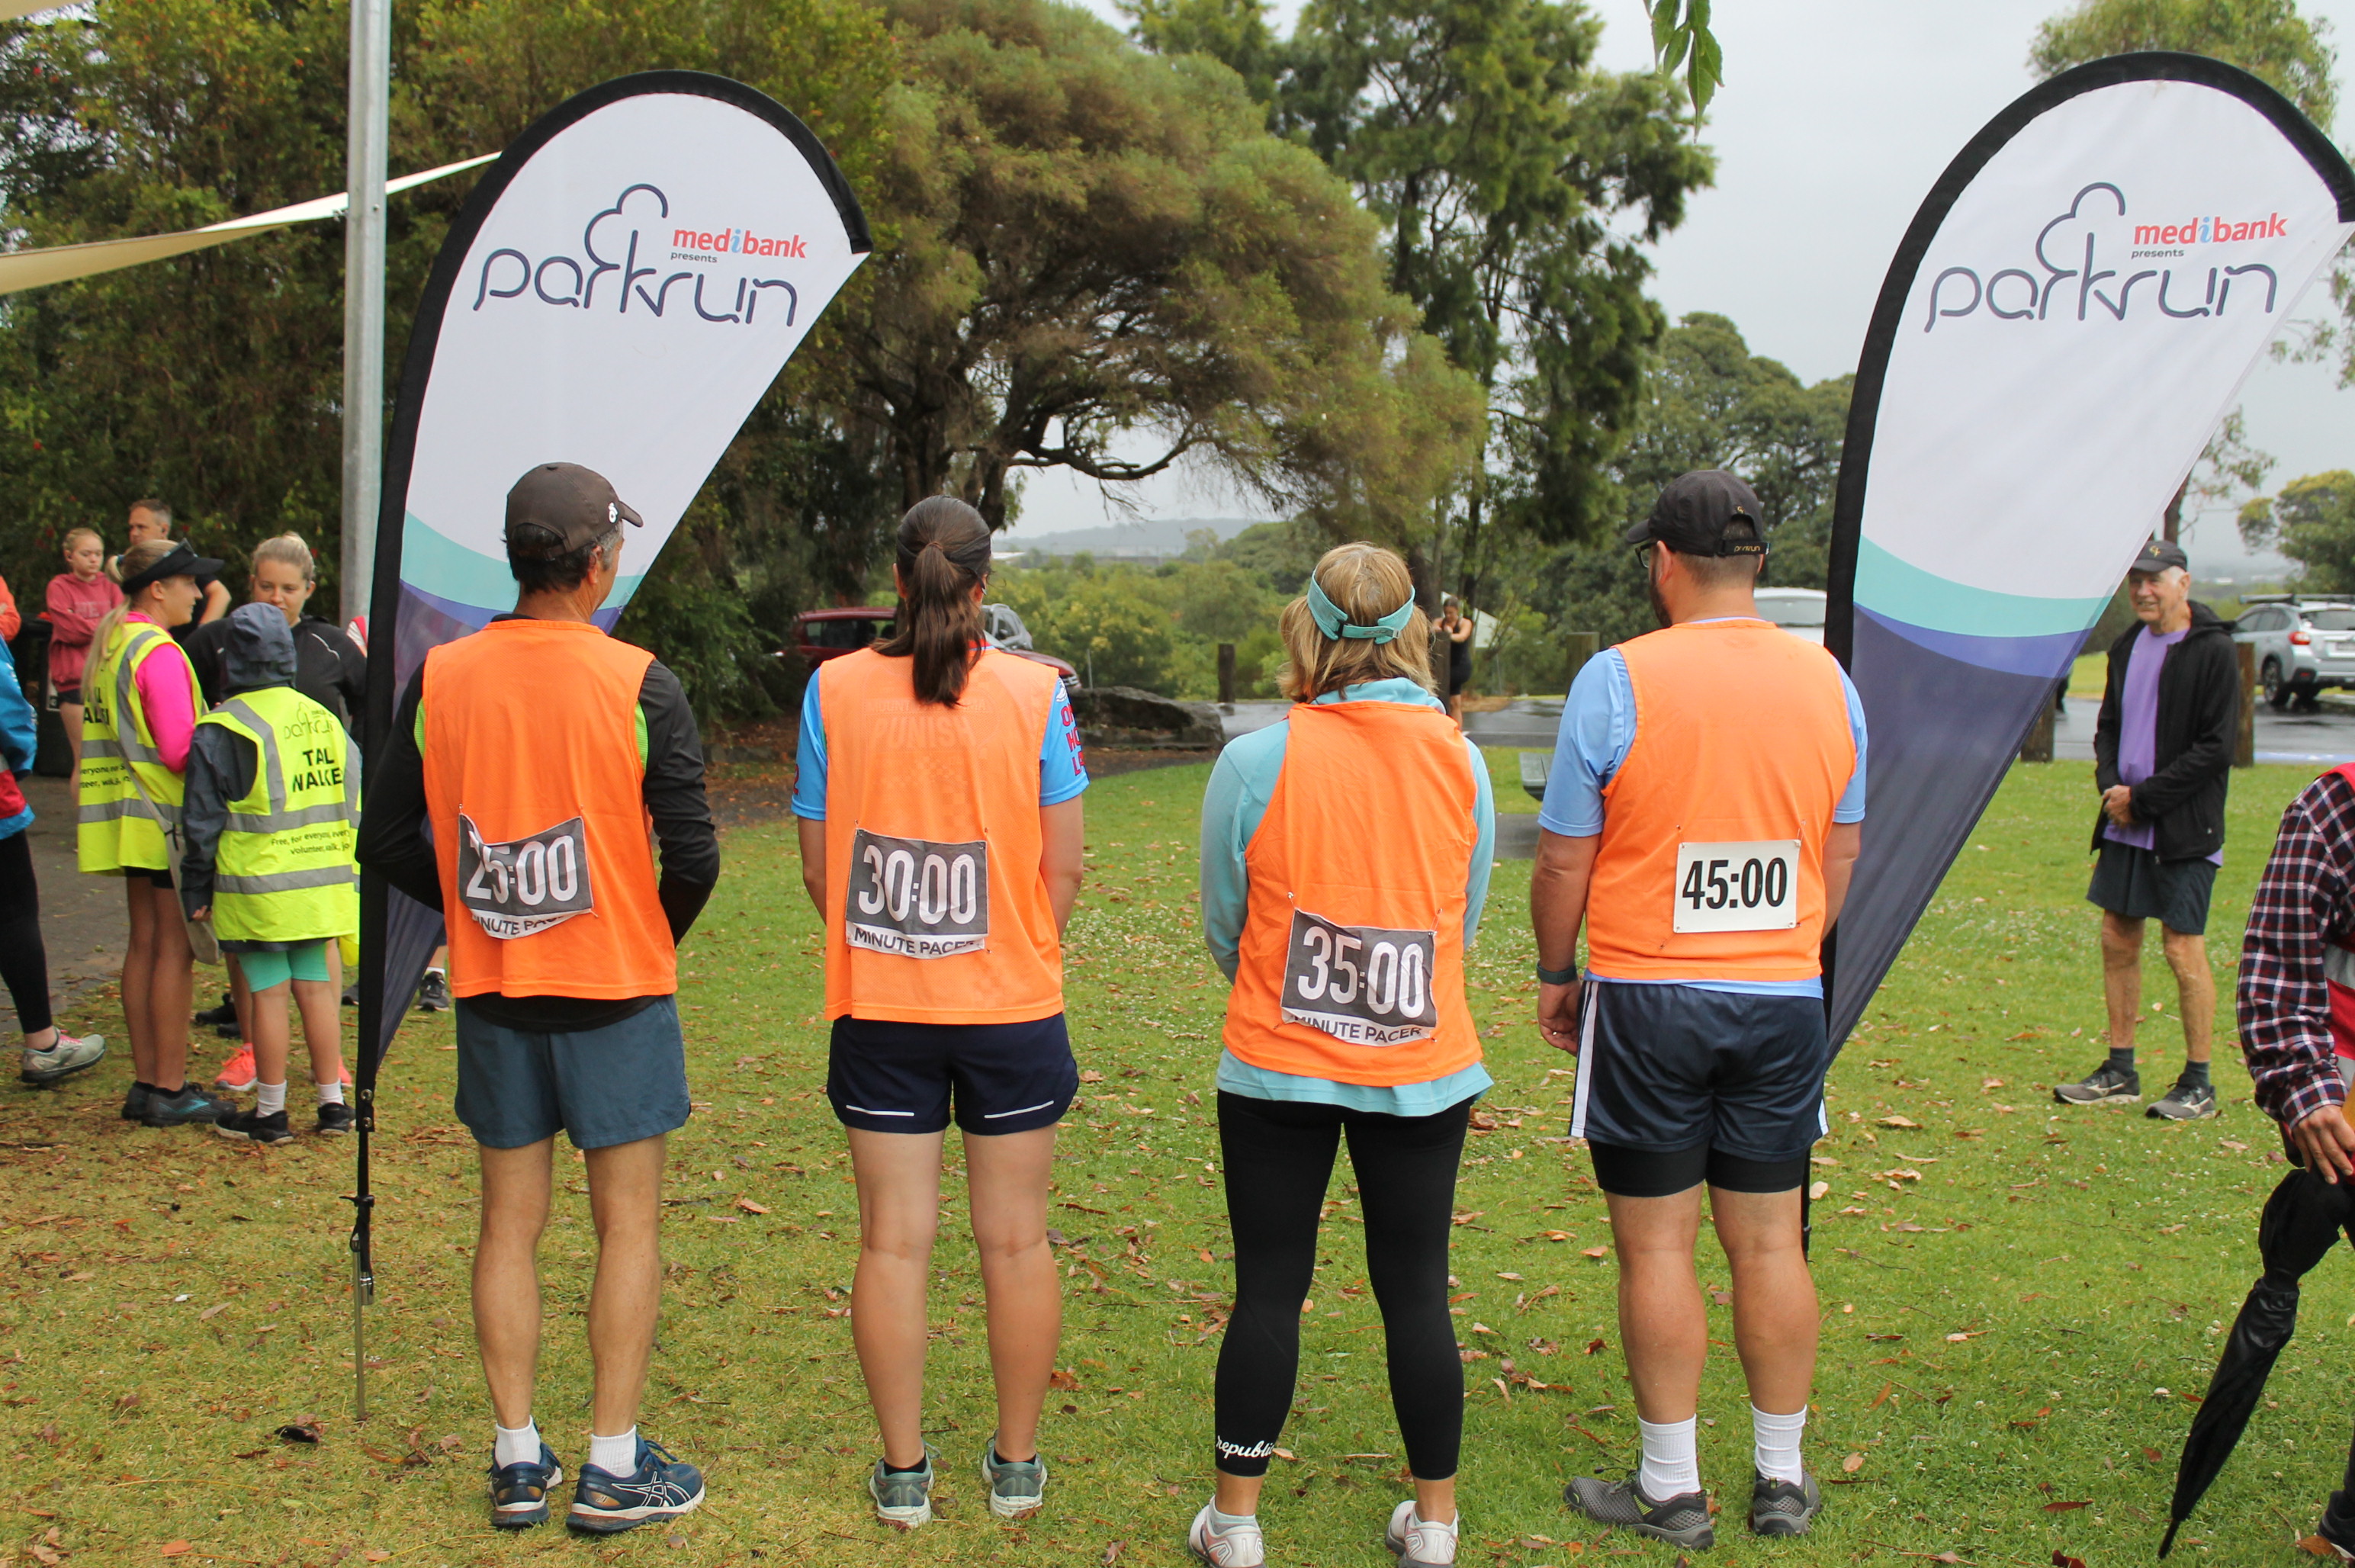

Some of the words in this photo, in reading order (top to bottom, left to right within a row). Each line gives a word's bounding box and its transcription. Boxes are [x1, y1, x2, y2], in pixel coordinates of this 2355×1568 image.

[473, 183, 798, 328] parkrun
[673, 228, 808, 259] medibank
[2131, 248, 2184, 259] presents
[2134, 212, 2288, 246] medibank
[670, 250, 718, 264] presents
[1924, 182, 2278, 333] parkrun
[466, 830, 578, 906] 25:00
[858, 844, 977, 925] 30:00
[1682, 857, 1788, 910] 45:00
[854, 927, 915, 953] MINUTE
[1297, 925, 1425, 1019] 35:00
